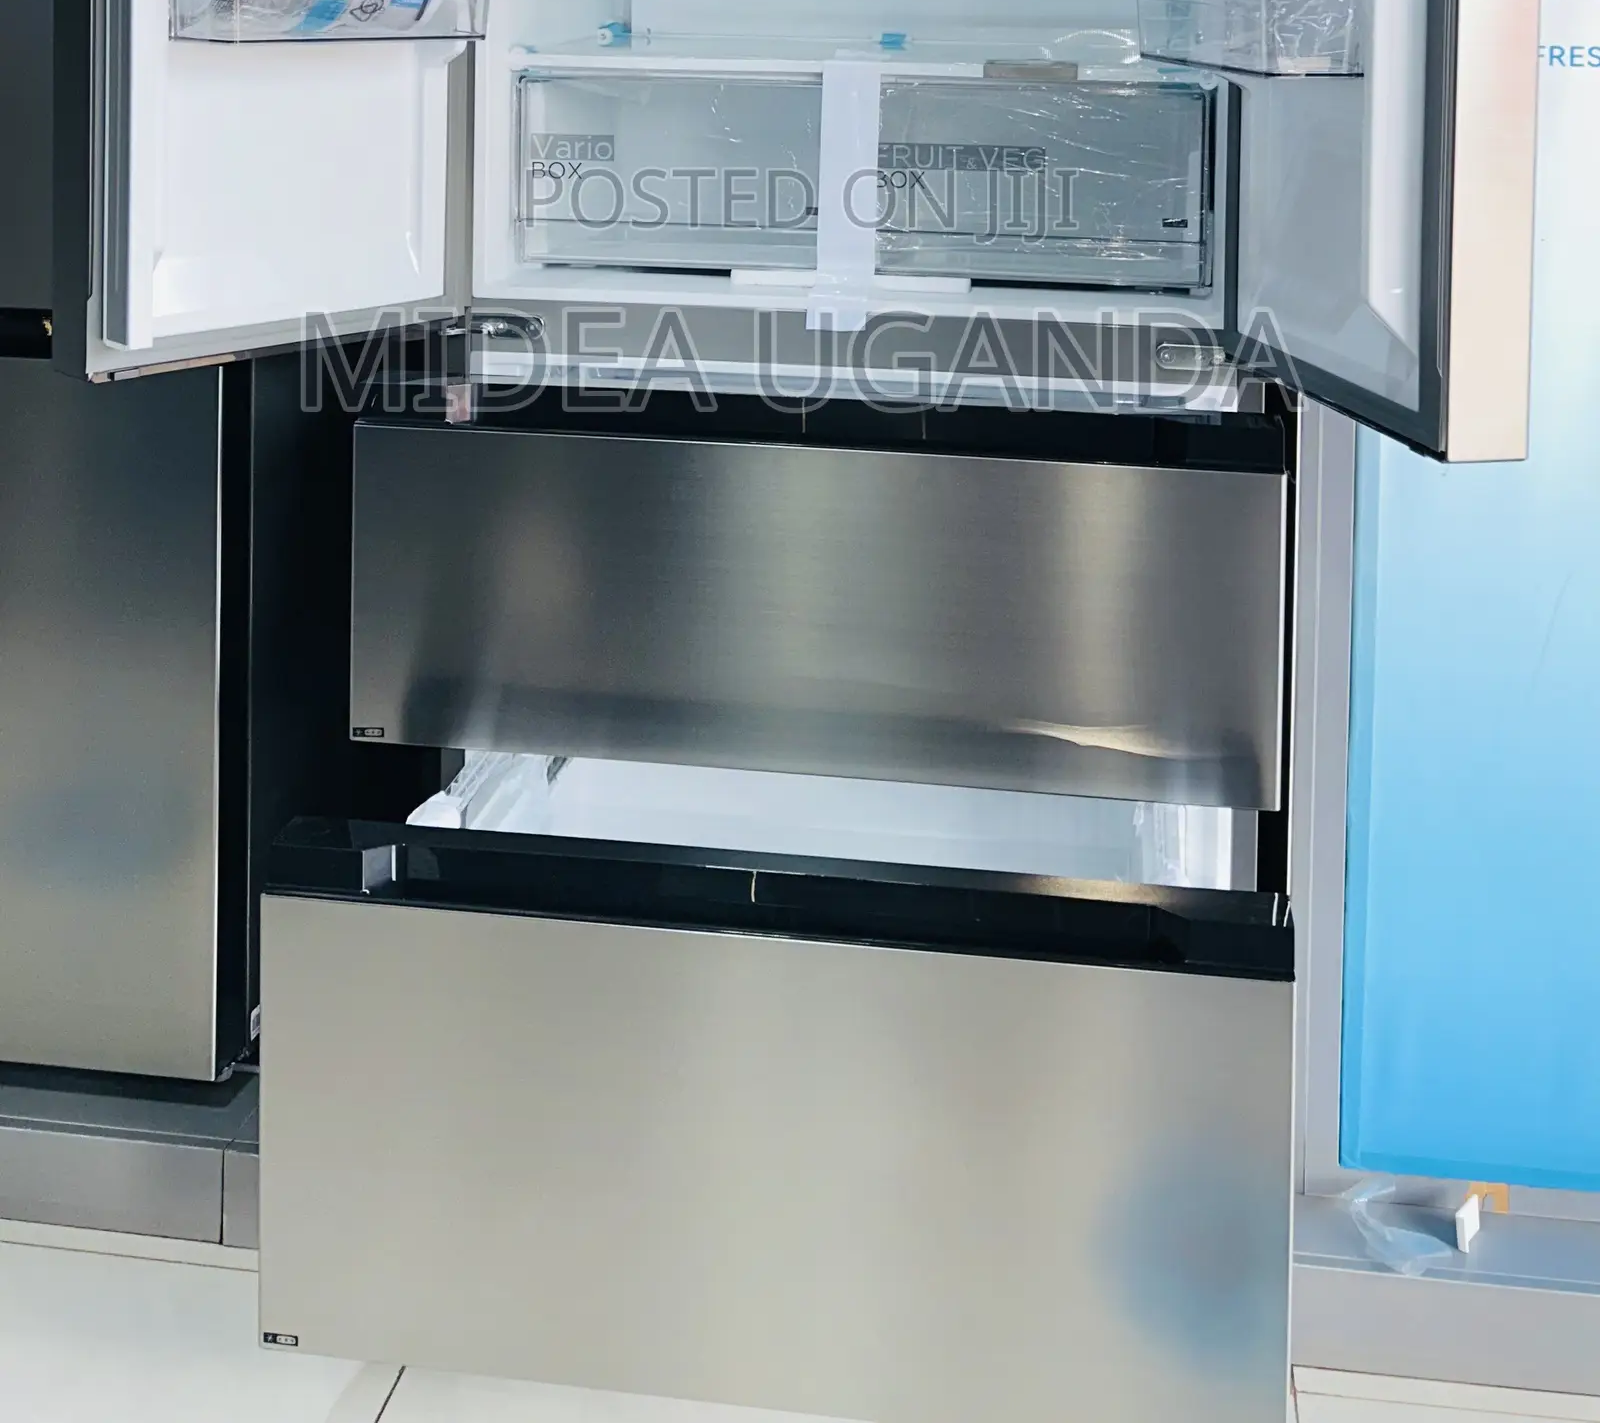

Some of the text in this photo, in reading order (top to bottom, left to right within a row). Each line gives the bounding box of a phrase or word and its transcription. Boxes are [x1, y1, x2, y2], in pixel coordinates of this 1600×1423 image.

[533, 135, 613, 160] Vario
[978, 146, 1046, 172] VEG
[531, 162, 582, 180] BOX
